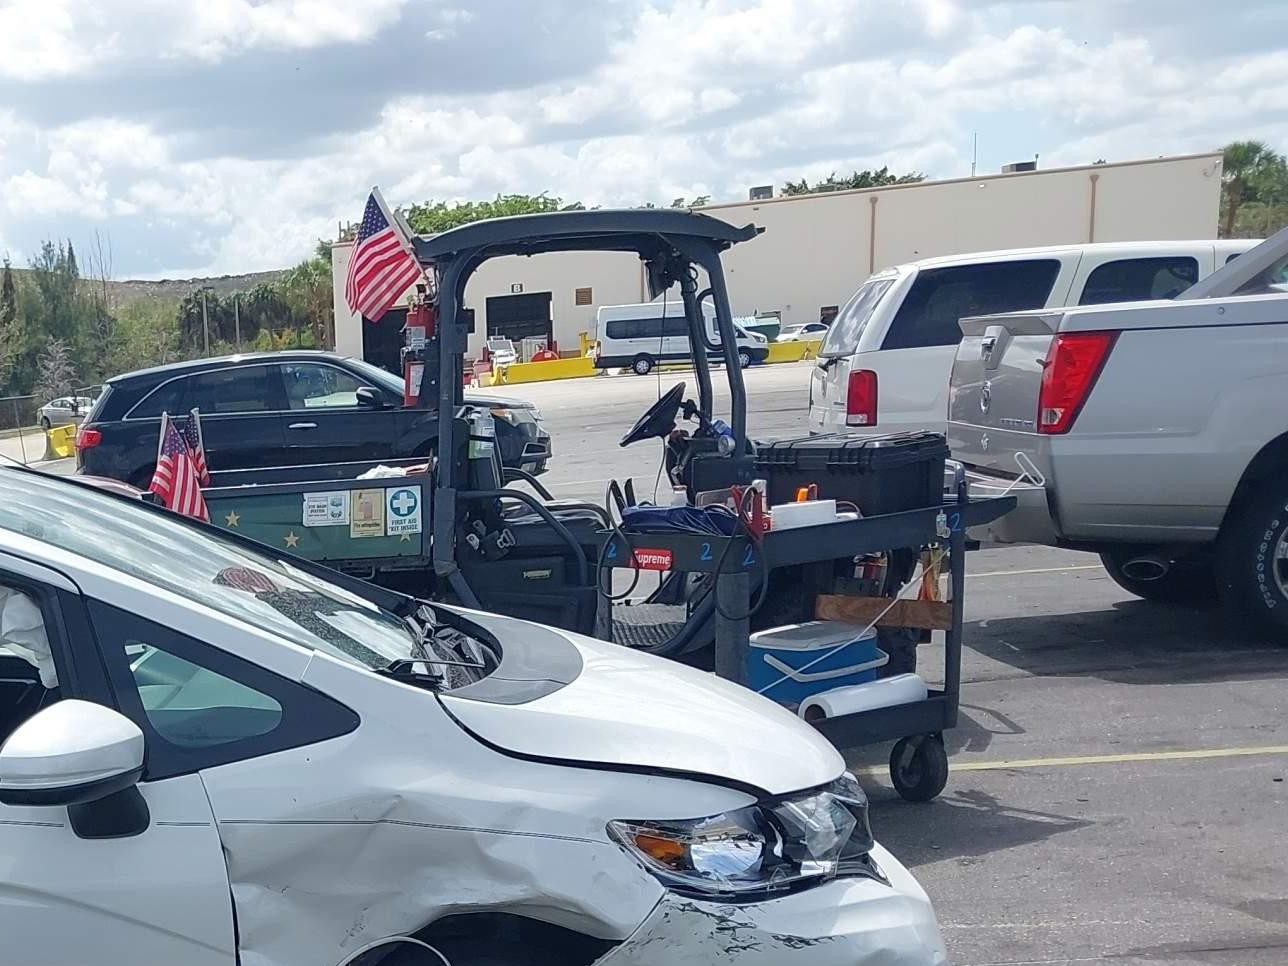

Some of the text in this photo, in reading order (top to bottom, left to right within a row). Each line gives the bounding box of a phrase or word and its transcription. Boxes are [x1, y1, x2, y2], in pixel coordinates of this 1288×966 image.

[951, 512, 961, 531] 2
[701, 543, 712, 560] 2
[743, 544, 755, 565] 2
